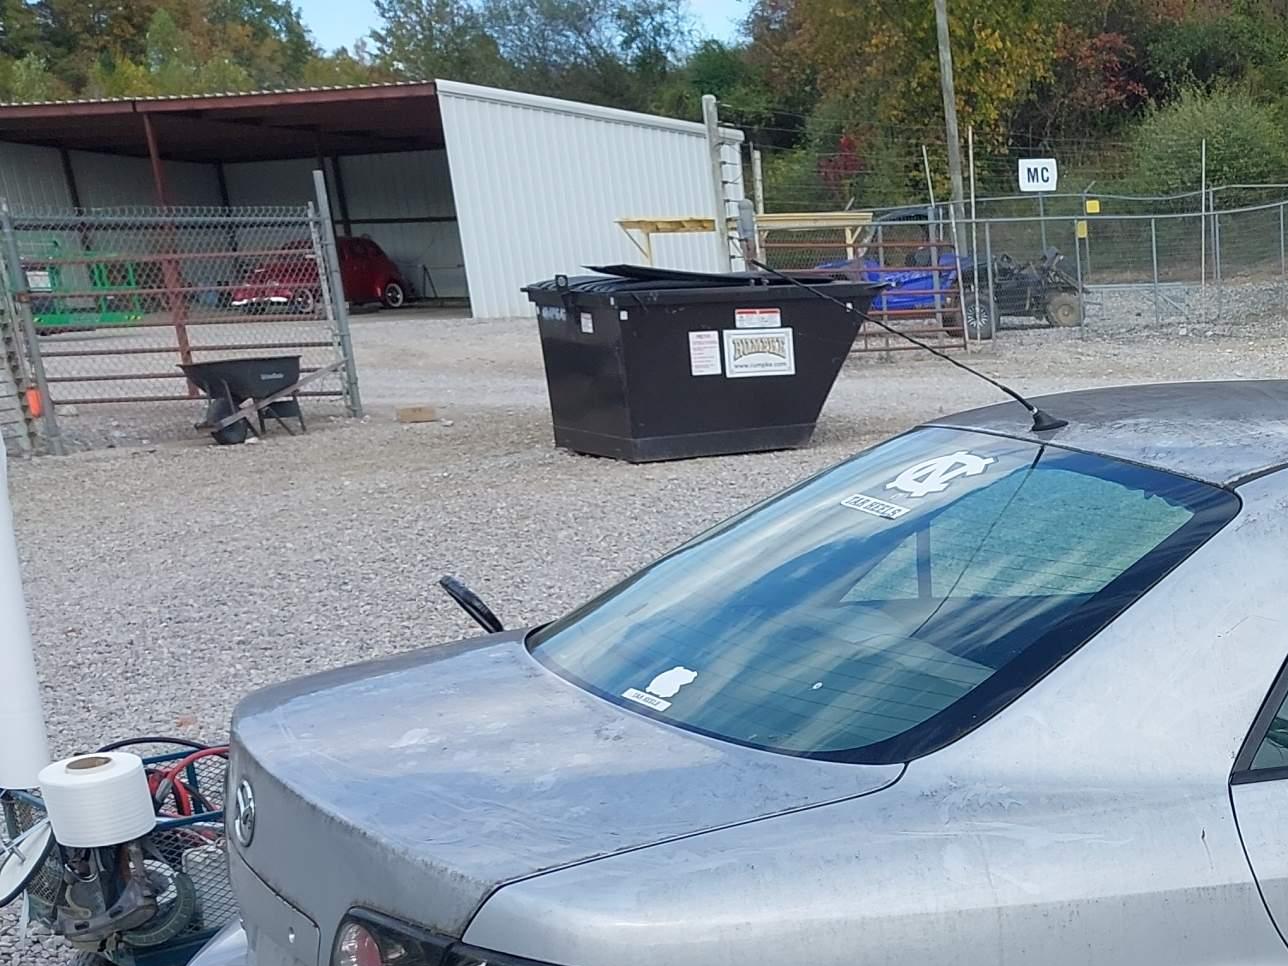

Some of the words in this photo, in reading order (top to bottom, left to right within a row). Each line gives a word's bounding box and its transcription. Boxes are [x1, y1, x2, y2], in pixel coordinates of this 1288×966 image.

[1026, 167, 1050, 183] MC
[845, 495, 870, 508] TAR
[863, 501, 903, 518] HEELS
